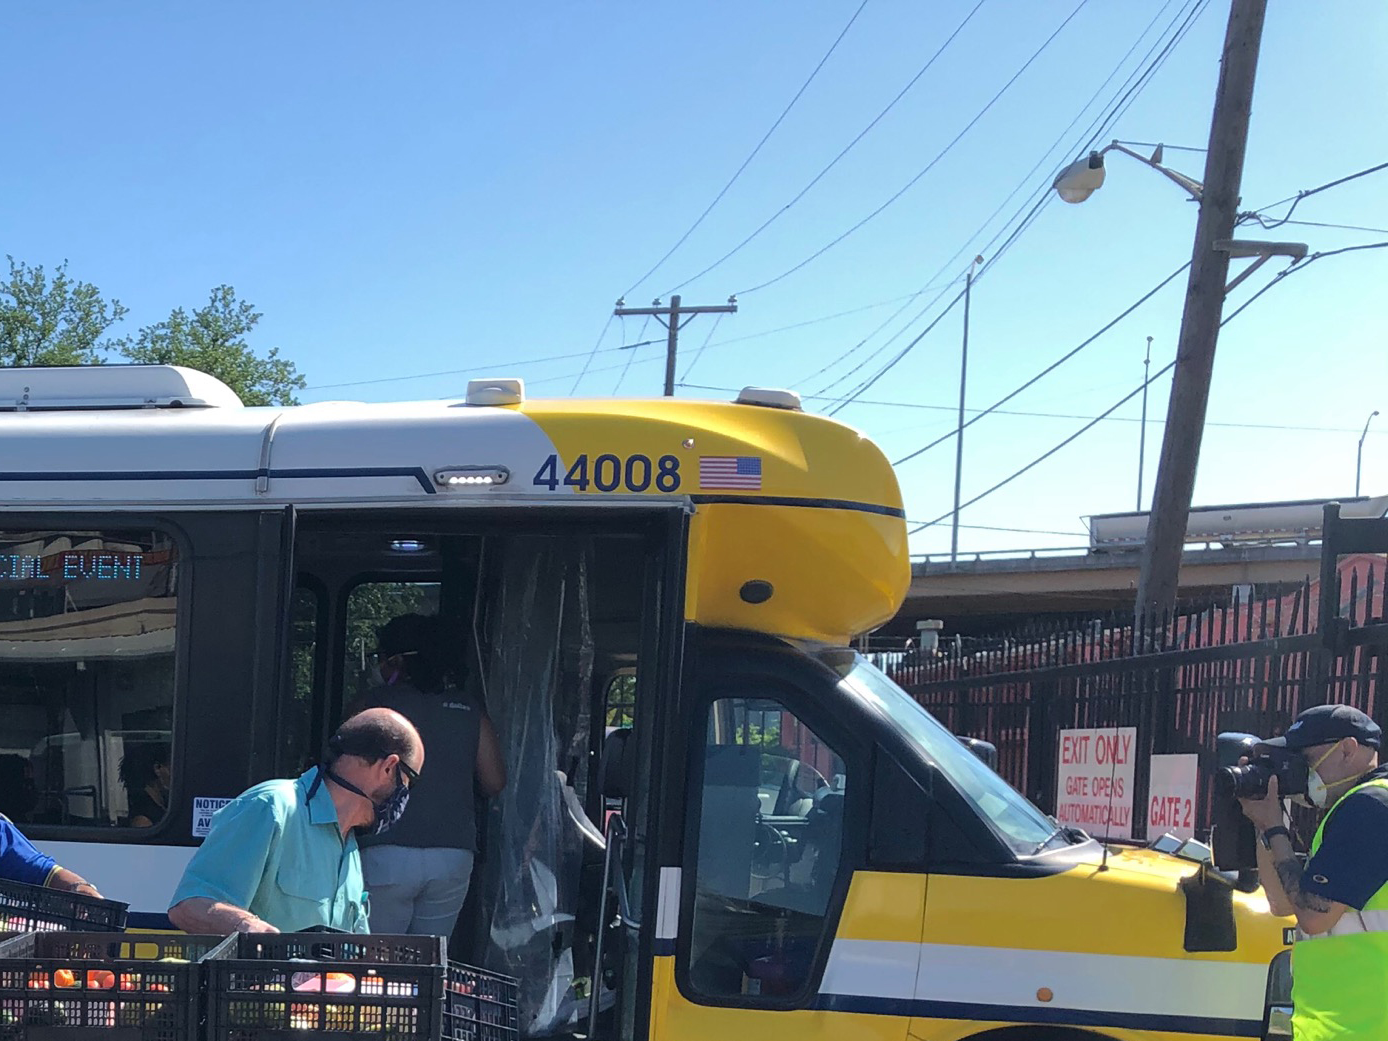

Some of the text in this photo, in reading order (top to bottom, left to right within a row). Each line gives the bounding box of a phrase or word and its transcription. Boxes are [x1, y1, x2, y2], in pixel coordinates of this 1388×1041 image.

[533, 454, 681, 492] 44008
[63, 554, 143, 579] EVENT
[1062, 735, 1132, 764] EXIT ONLY
[1066, 776, 1124, 798] GATE OPENS
[1059, 804, 1130, 827] AUTOMATICALLY
[1150, 796, 1192, 827] GATE 2
